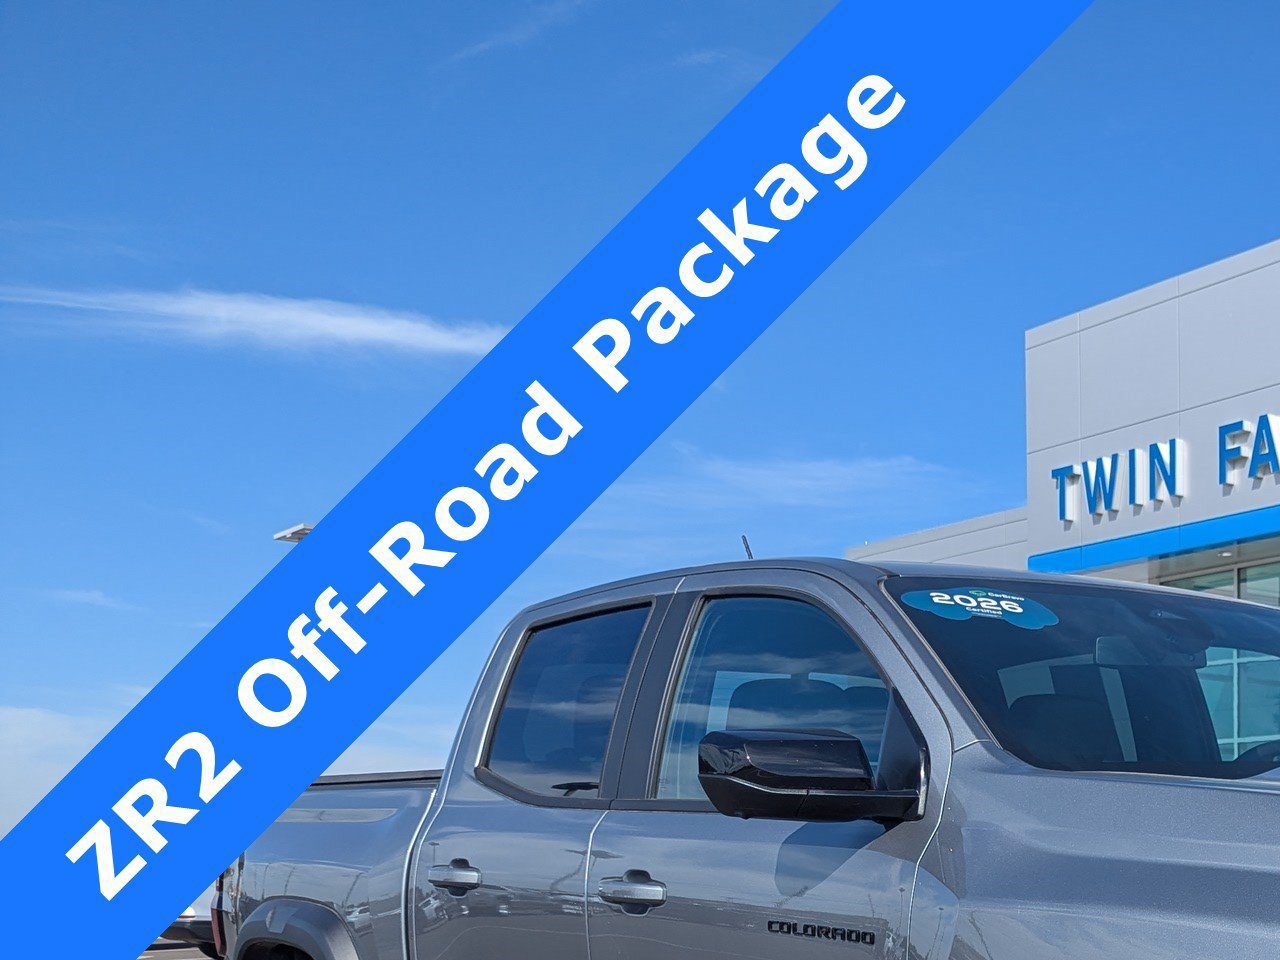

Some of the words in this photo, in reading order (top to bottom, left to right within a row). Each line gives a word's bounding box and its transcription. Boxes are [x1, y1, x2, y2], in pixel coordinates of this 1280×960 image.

[1051, 438, 1184, 522] TWIN
[929, 592, 1024, 613] 2026
[767, 920, 875, 945] COLORADO
